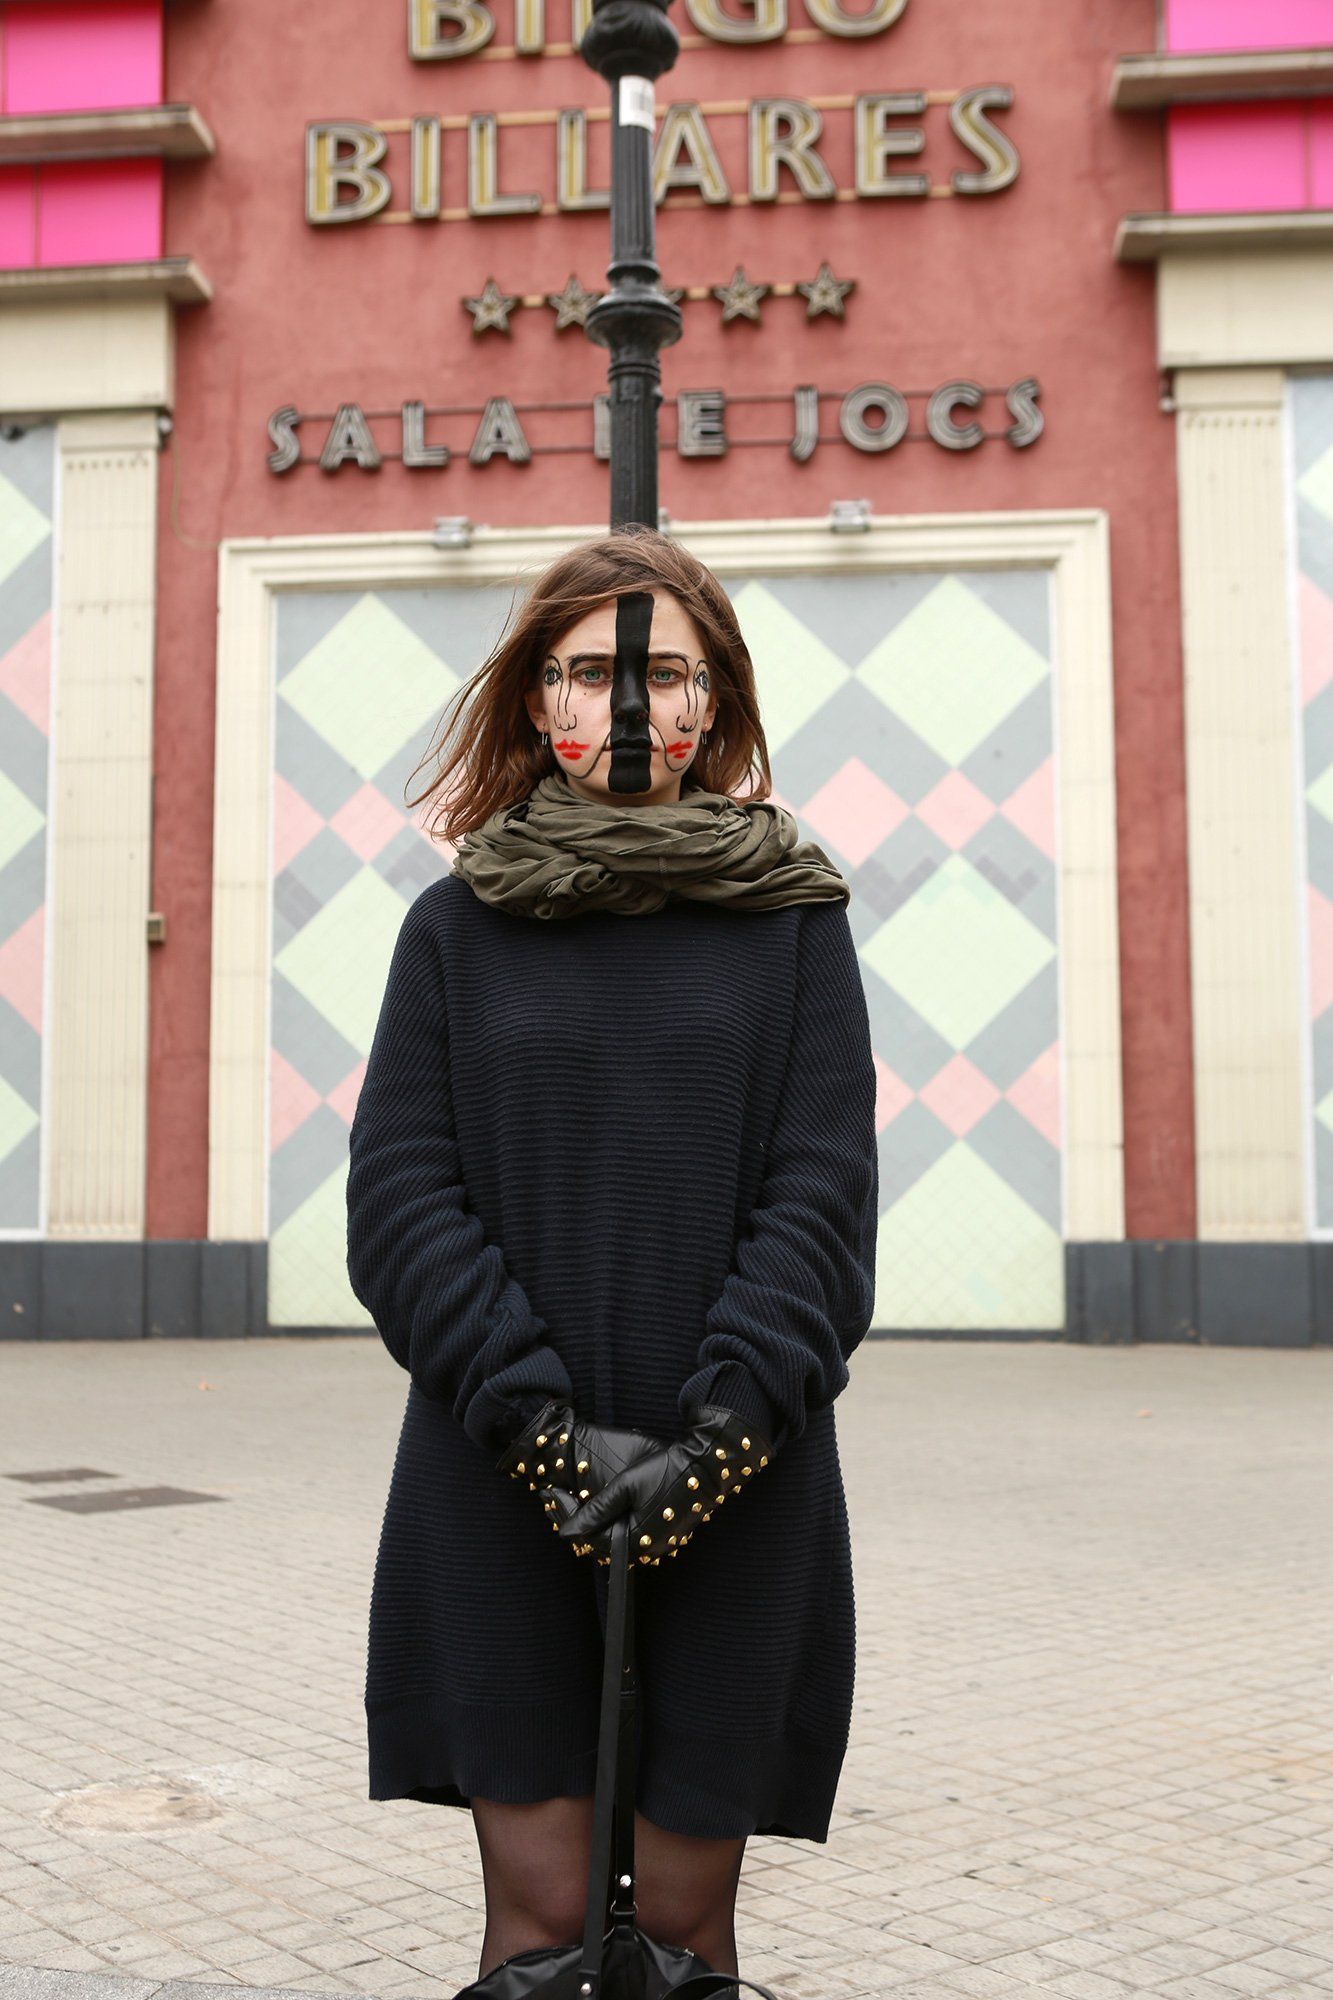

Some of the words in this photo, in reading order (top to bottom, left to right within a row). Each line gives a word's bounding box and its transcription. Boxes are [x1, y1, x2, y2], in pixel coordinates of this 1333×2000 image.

[305, 85, 1021, 225] BILLARES
[266, 396, 532, 473] SALA
[594, 389, 726, 459] E
[789, 377, 1045, 463] JOCS
